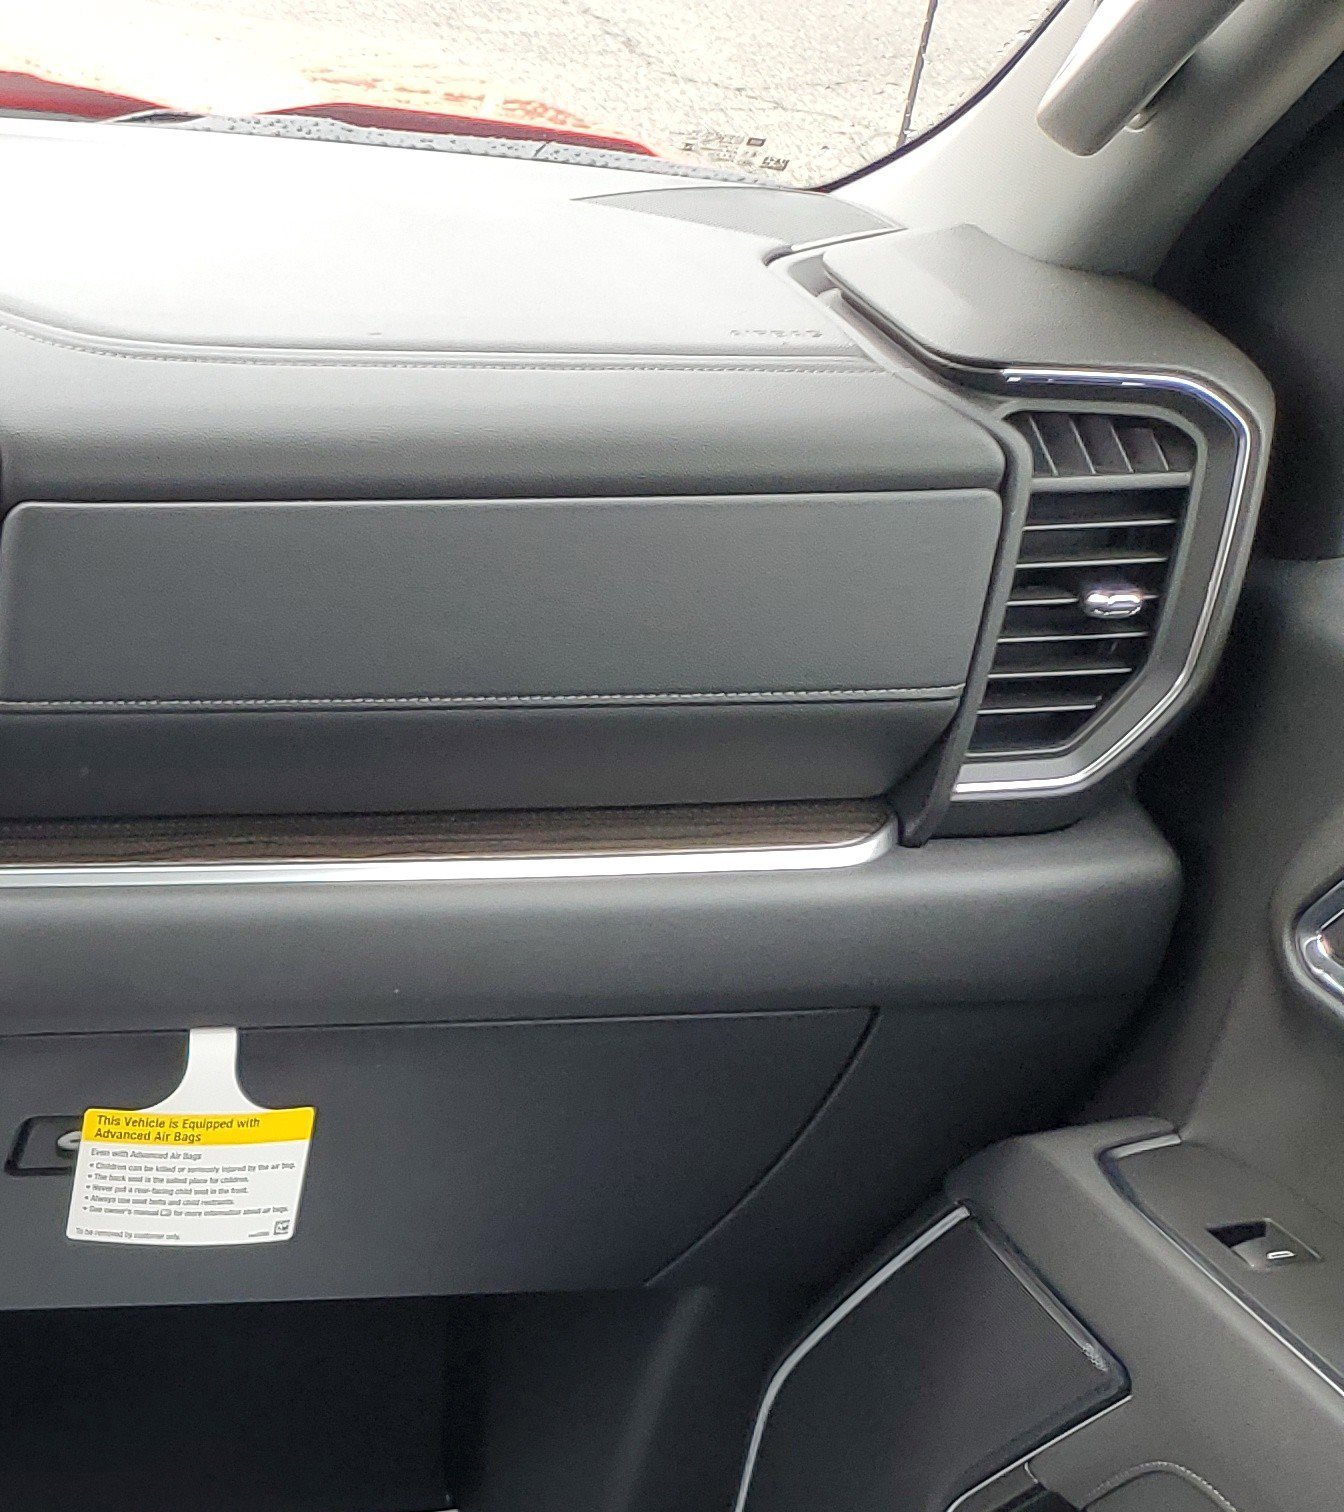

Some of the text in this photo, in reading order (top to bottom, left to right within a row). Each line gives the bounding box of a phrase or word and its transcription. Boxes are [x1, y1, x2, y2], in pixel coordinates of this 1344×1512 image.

[97, 1114, 260, 1131] This Vehicle is Equipped with
[94, 1128, 201, 1144] Advanced Air Bags
[91, 1147, 110, 1157] Even
[170, 1151, 181, 1160] Air
[183, 1152, 202, 1161] Bags
